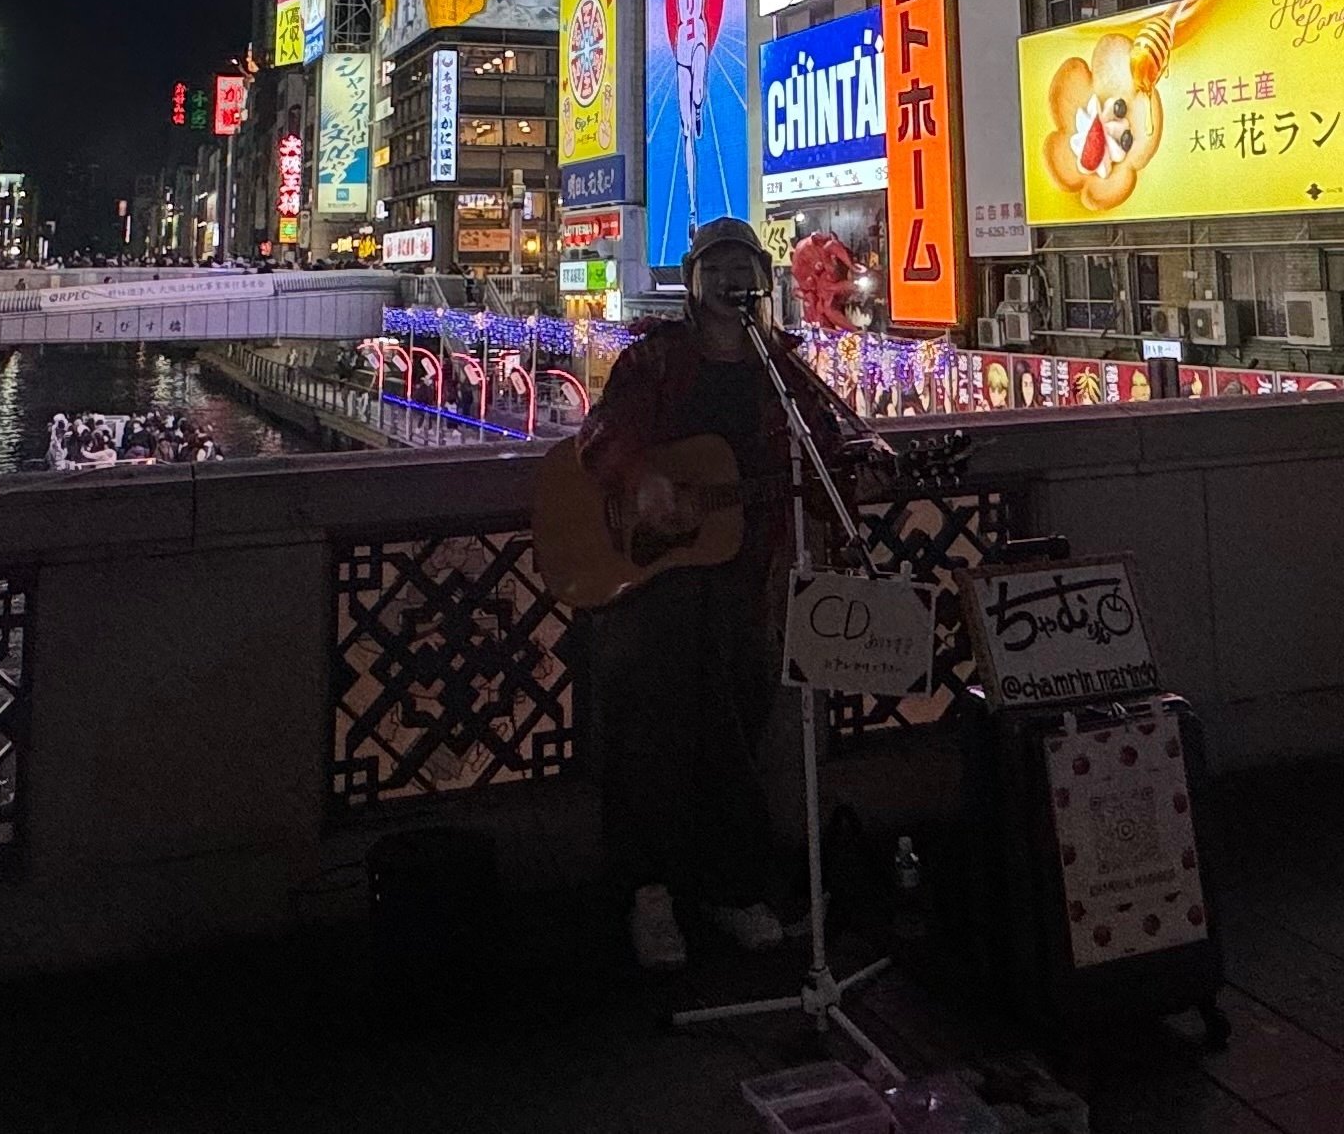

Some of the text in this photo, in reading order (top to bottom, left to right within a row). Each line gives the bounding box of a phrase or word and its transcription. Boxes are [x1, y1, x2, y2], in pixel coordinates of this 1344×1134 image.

[767, 49, 887, 158] CHINTAI
[1185, 71, 1276, 111] 大阪土産
[1189, 127, 1226, 155] 大阪
[564, 224, 592, 236] LOTTERIA
[810, 596, 870, 641] CD
